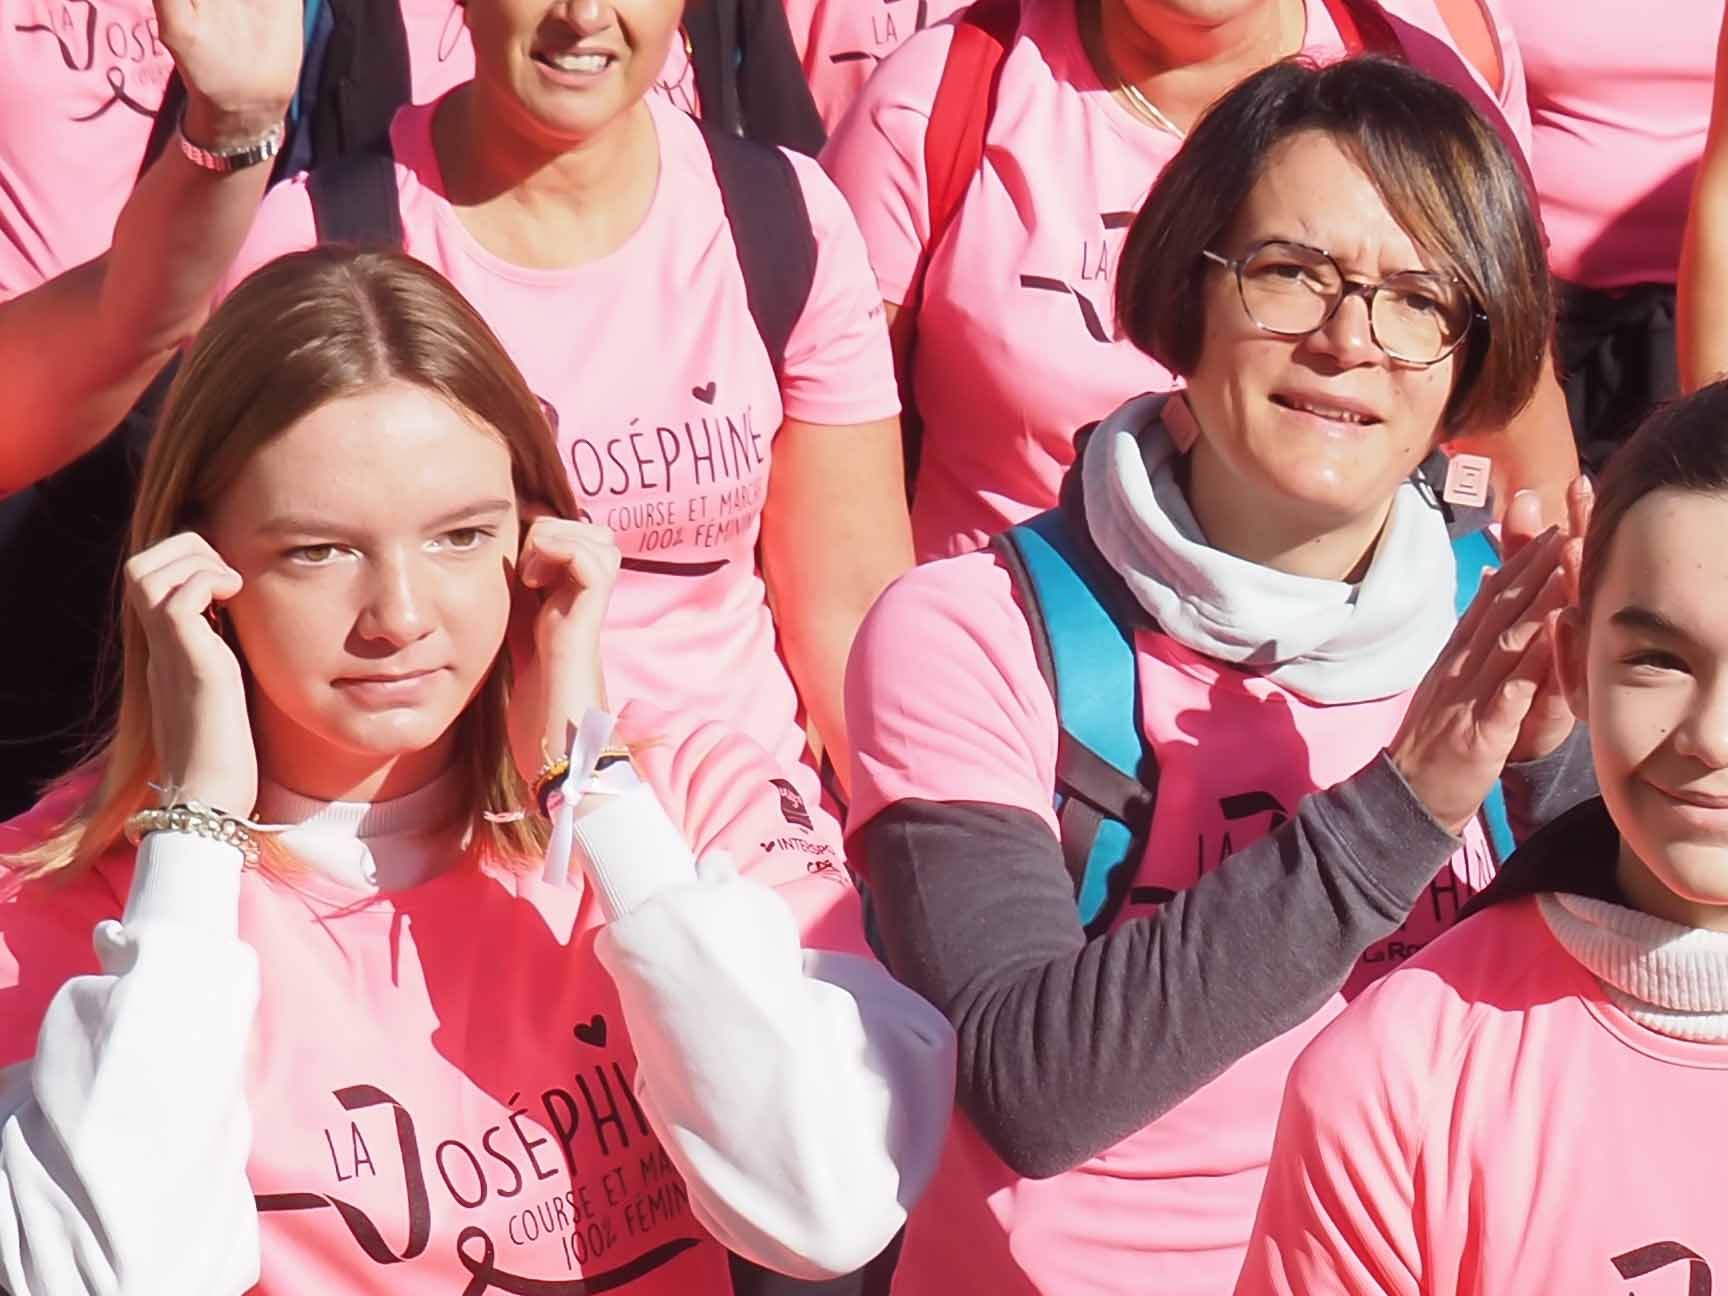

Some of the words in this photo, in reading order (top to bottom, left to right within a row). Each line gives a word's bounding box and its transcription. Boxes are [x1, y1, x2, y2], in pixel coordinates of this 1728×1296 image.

[871, 11, 898, 45] LA
[1081, 240, 1108, 281] LA
[571, 407, 764, 497] OSÉPHINE
[607, 501, 676, 533] COURSE
[688, 495, 708, 522] ET
[639, 525, 685, 553] 100%
[323, 1120, 376, 1184] LA
[333, 1061, 666, 1264] JOSÉPHI
[508, 1186, 596, 1246] COURSE
[602, 1167, 628, 1205] ET
[562, 1218, 617, 1271] 100%
